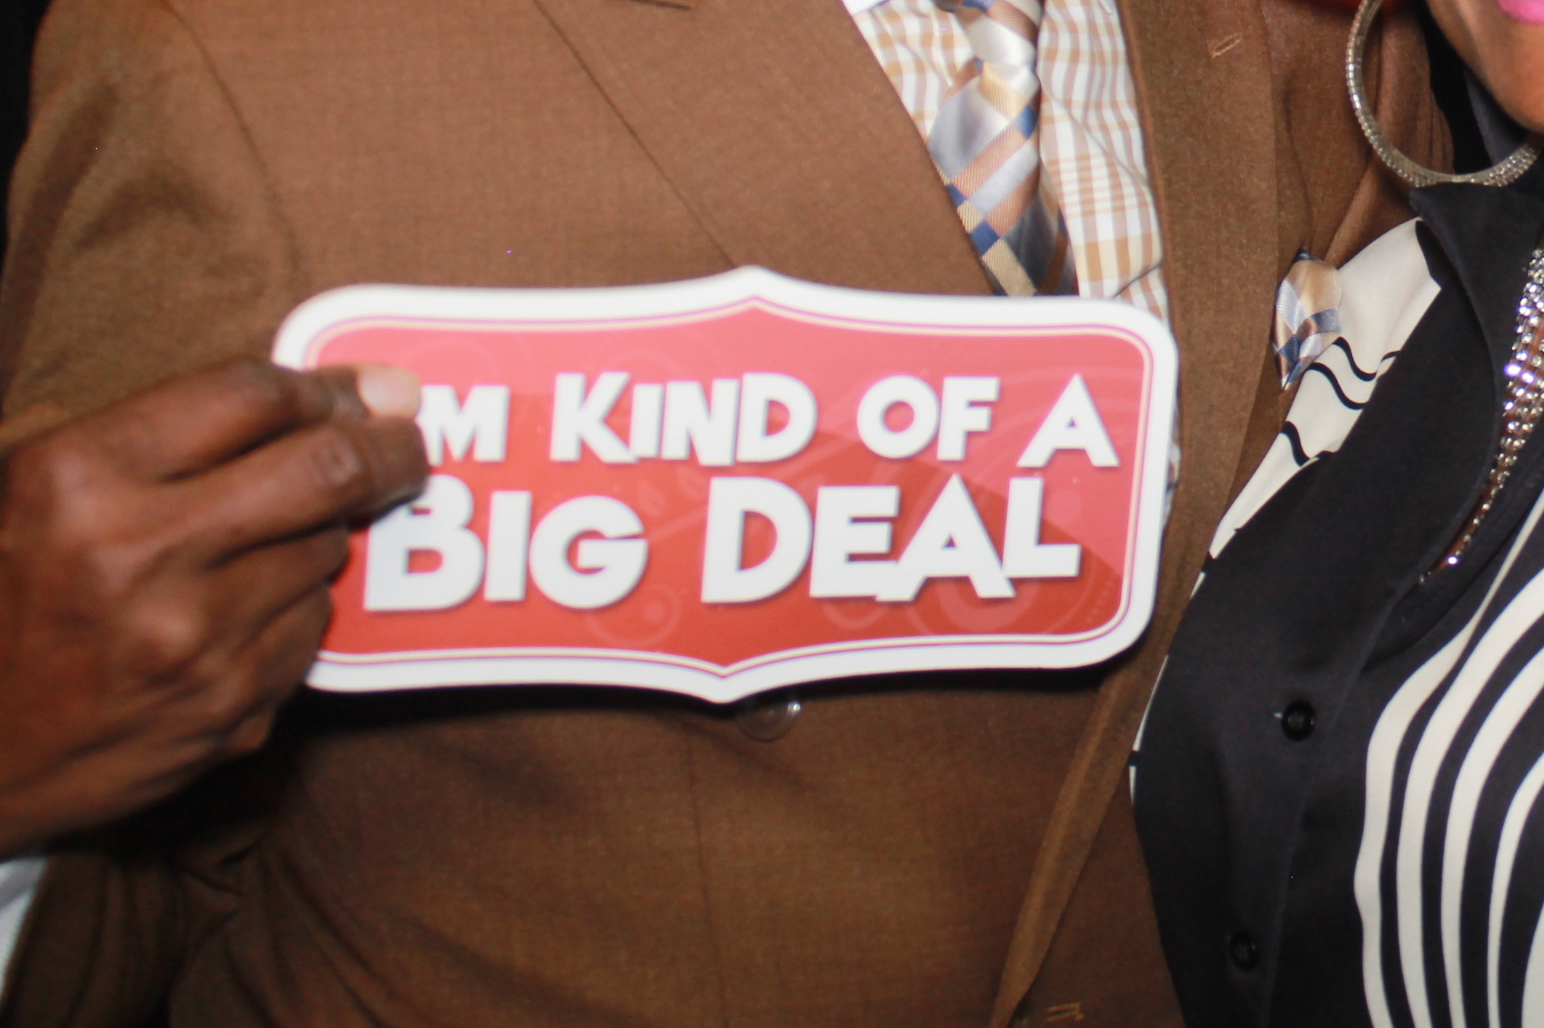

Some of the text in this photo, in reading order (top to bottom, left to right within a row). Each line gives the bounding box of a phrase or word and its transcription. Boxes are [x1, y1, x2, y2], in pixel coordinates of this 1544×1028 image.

[417, 371, 1119, 467] M KIND OF A
[364, 474, 1081, 611] BIG DEAL
